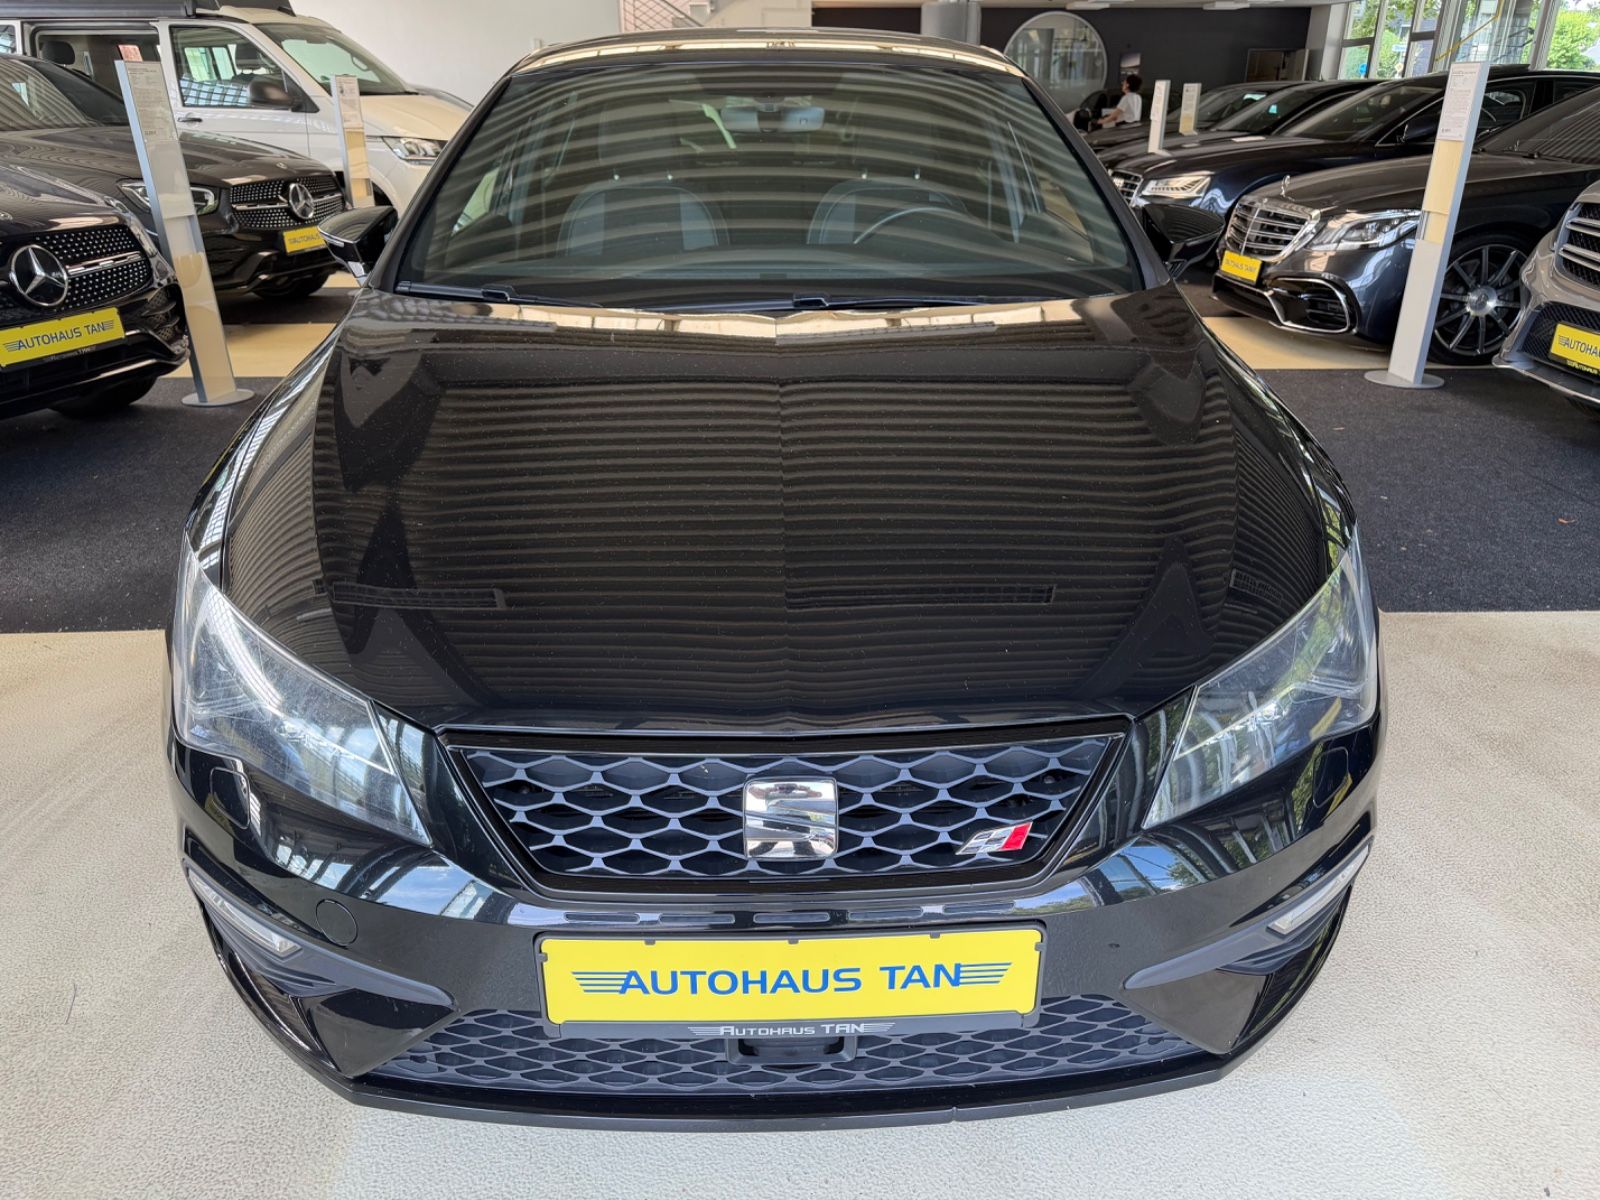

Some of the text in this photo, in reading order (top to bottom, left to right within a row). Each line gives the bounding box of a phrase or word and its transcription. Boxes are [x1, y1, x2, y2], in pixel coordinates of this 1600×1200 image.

[17, 322, 105, 350] AUTOHAUS TAN
[618, 963, 961, 996] AUTOHAUS TAN
[821, 1022, 866, 1035] TAN
